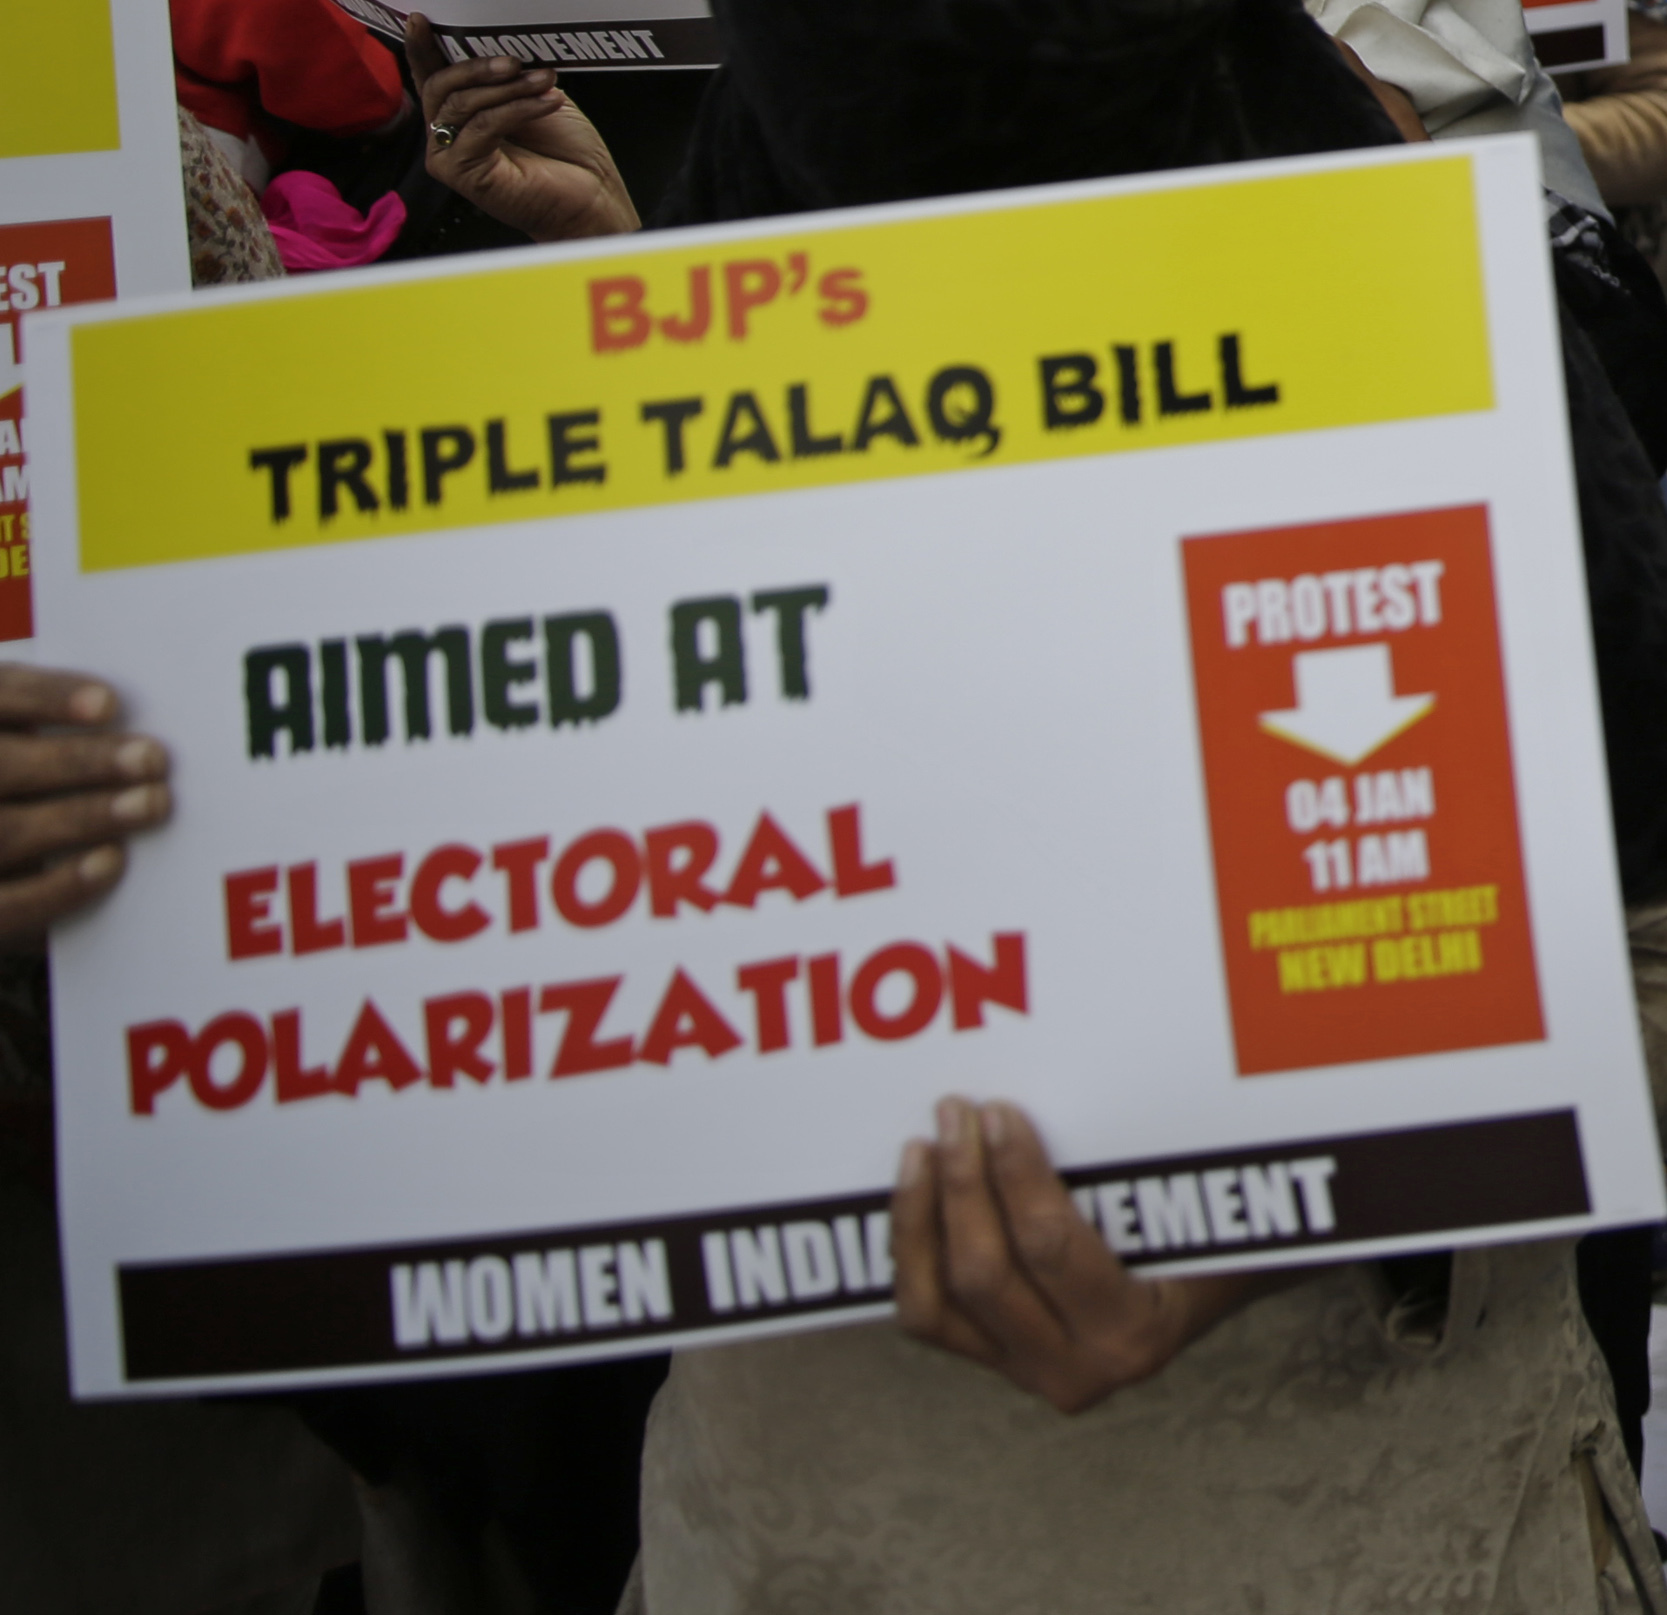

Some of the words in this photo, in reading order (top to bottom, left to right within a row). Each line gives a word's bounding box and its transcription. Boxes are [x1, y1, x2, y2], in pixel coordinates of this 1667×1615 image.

[587, 254, 870, 354] BJP's
[250, 407, 606, 525] TRIPLE
[643, 363, 1000, 476] TALAQ
[1036, 332, 1279, 432] BILL
[1221, 559, 1446, 650] PROTEST
[243, 610, 622, 761] AIMED
[671, 583, 830, 717] AT
[1285, 776, 1350, 835] 04
[1353, 767, 1435, 825] JAN
[223, 804, 897, 961] ELECTORAL
[1303, 837, 1353, 893] 11
[1357, 829, 1430, 887] AM
[1249, 894, 1402, 950] PARLIAMENT
[1406, 884, 1498, 932] STREET
[1278, 942, 1366, 994] NEW
[1372, 929, 1483, 984] DELHI
[125, 931, 1031, 1116] POLARIZATION
[389, 1237, 672, 1348] WOMEN
